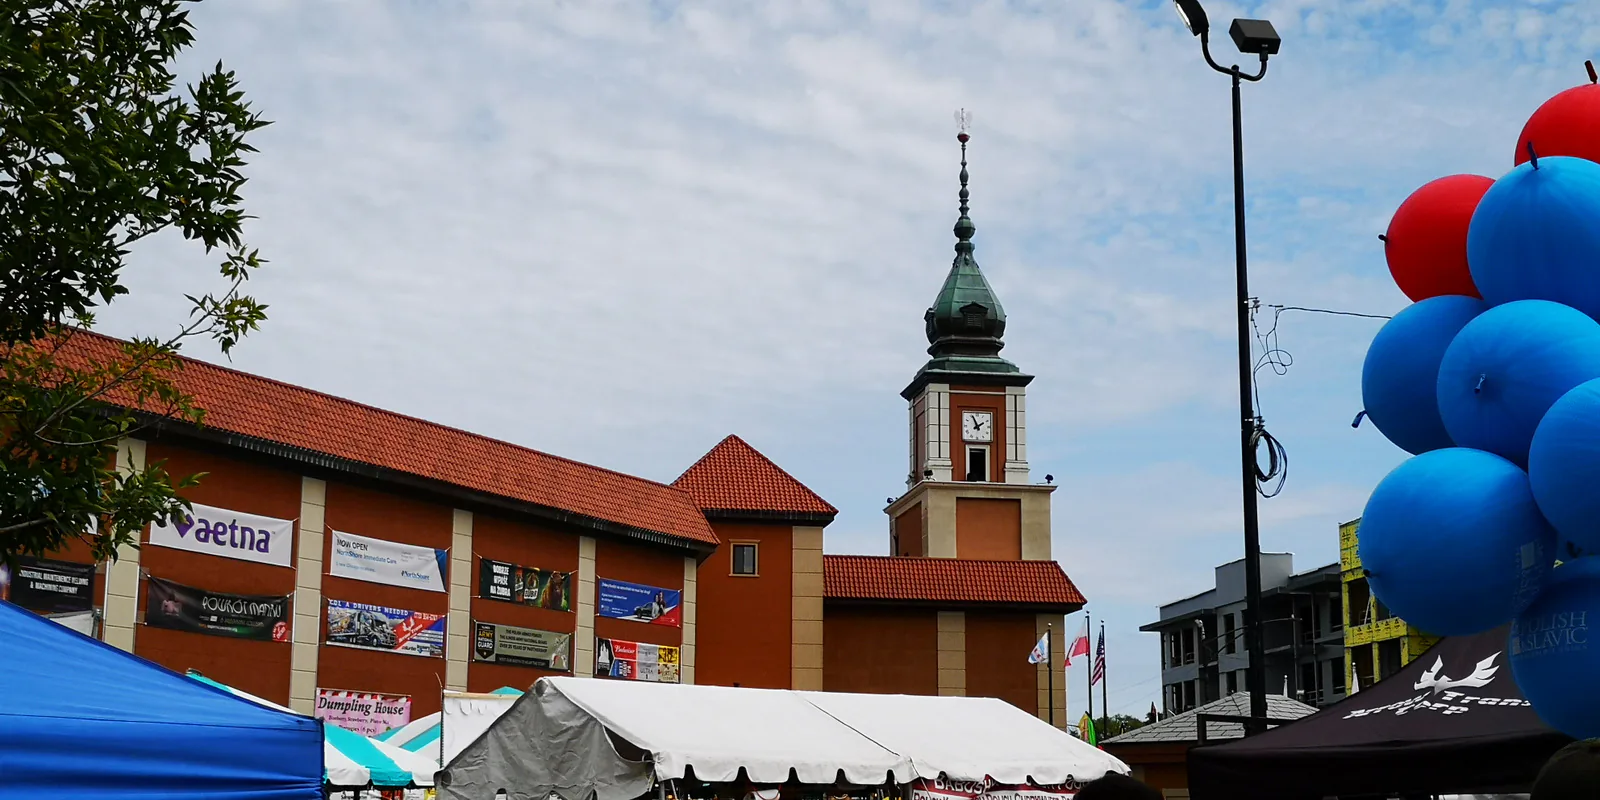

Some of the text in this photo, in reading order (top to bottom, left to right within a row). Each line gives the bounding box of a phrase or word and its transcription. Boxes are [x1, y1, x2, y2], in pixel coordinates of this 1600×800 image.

[195, 518, 270, 553] aetna
[352, 542, 368, 551] OPEN
[336, 548, 363, 559] NorthShore
[364, 553, 386, 564] Immediate
[492, 564, 510, 575] DOBRZE
[490, 585, 497, 594] NA
[353, 602, 382, 612] DRIVERS
[384, 607, 409, 616] NEEDED
[1520, 610, 1587, 635] POLISH
[478, 630, 493, 639] ARMY
[1528, 627, 1588, 650] SLAVIC
[477, 641, 493, 649] GUARD
[614, 645, 635, 654] Budweiser
[317, 697, 404, 716] Dumpling House
